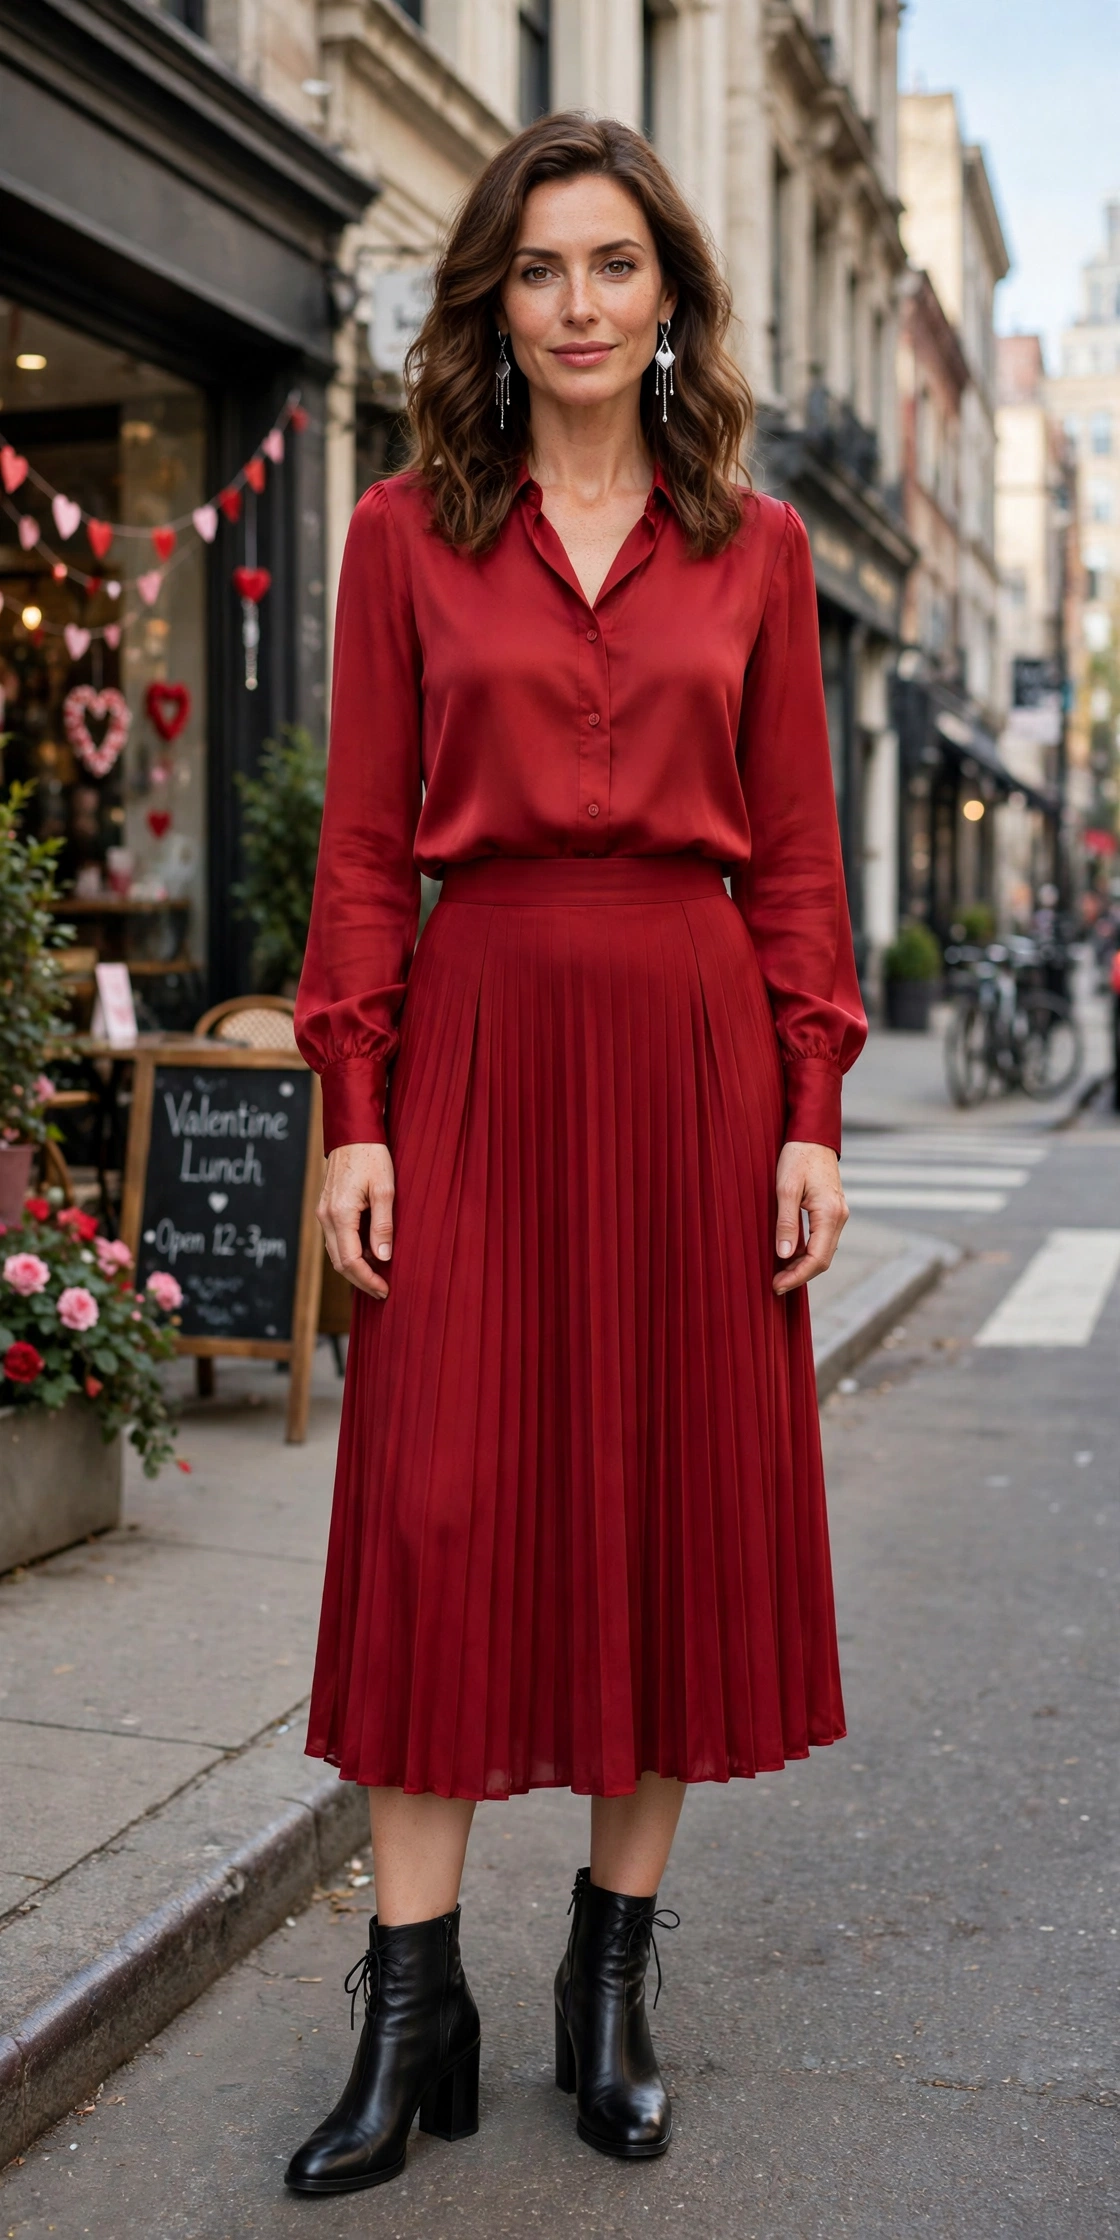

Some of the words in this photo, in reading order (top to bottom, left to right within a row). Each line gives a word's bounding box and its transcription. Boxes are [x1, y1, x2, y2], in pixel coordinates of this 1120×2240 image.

[165, 1091, 288, 1139] Valentine
[181, 1139, 263, 1185] Lunch
[157, 1218, 204, 1264] Open
[212, 1223, 286, 1267] 12-3pm
